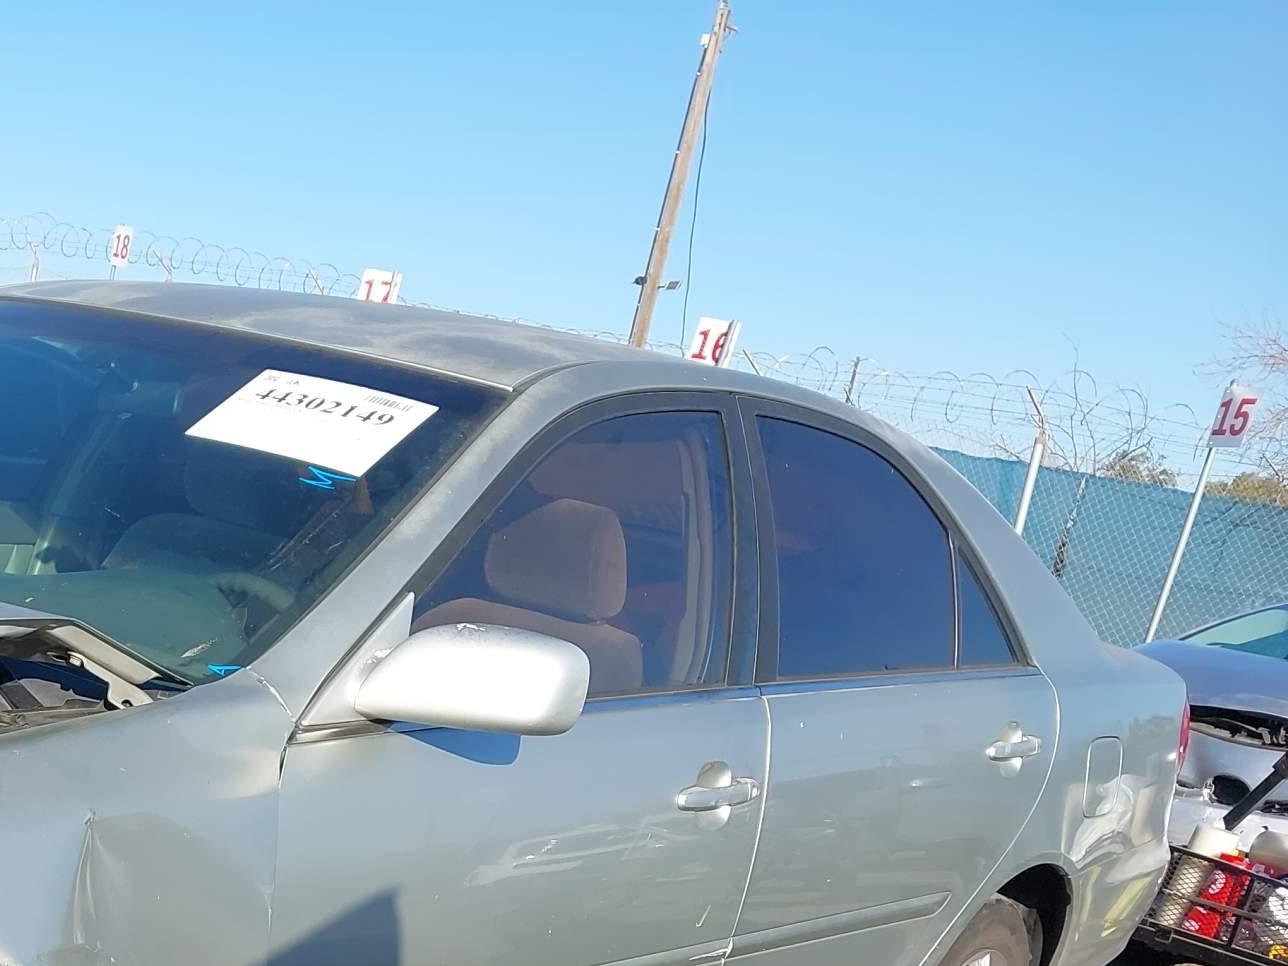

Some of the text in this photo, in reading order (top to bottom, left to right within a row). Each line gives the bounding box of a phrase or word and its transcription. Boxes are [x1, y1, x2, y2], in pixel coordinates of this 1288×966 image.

[112, 233, 130, 260] 18
[364, 279, 393, 304] 17
[255, 388, 395, 426] 44302149
[1212, 398, 1257, 436] 15
